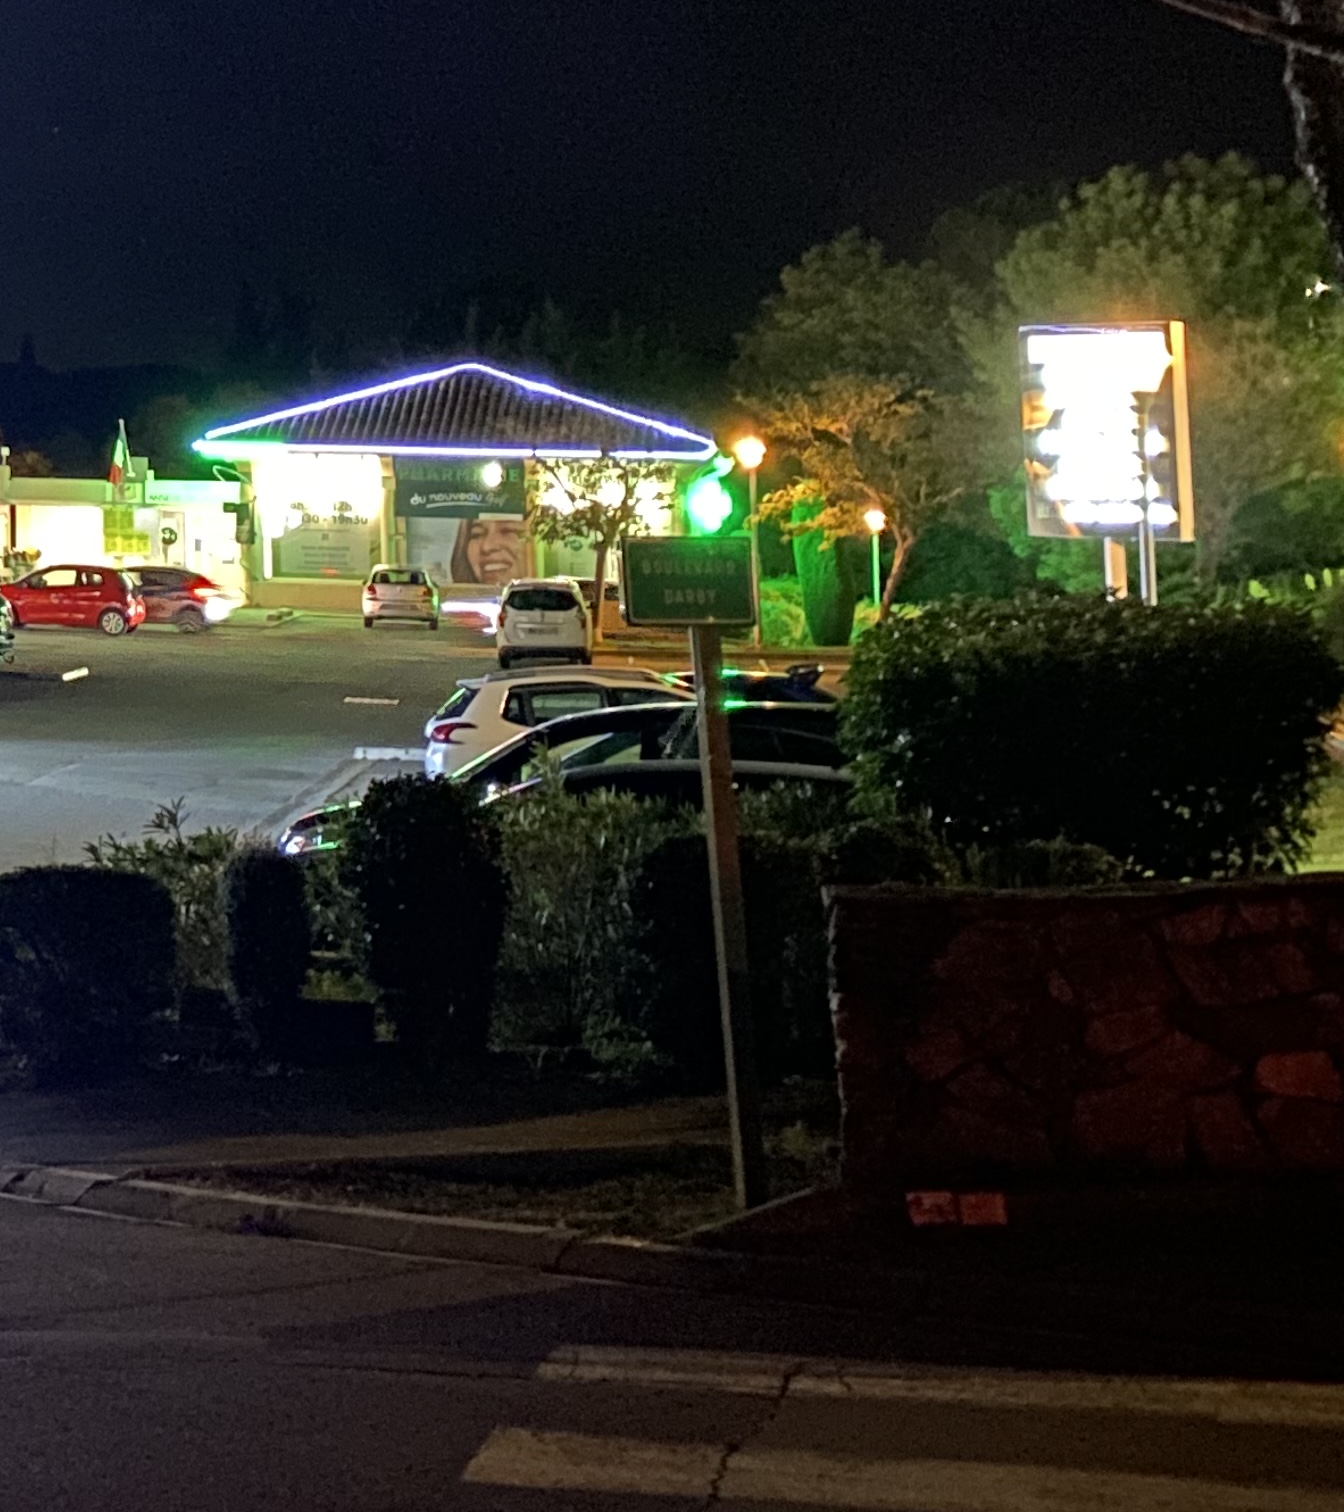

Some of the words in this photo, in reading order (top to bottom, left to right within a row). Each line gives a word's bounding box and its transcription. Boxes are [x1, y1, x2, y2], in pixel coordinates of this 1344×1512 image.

[398, 467, 521, 483] PHARMAIE
[410, 493, 427, 505] du
[429, 492, 483, 502] nouveau
